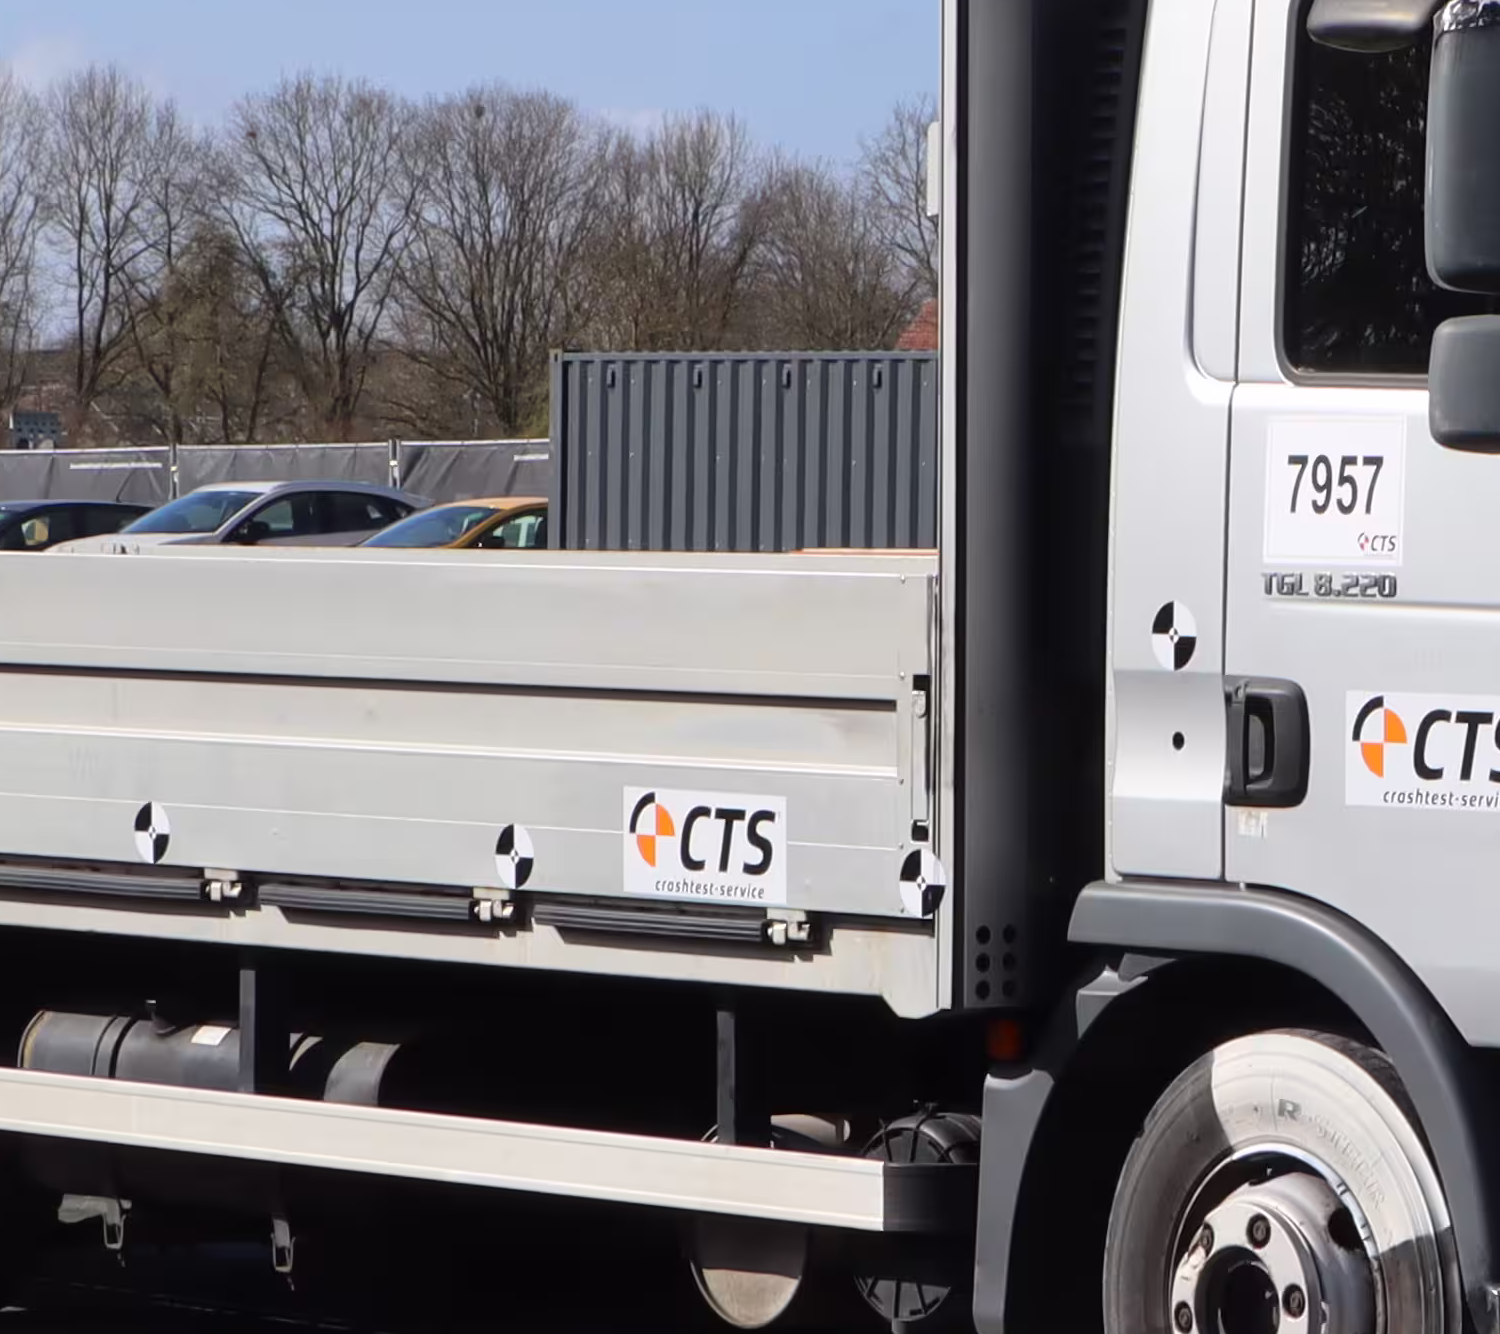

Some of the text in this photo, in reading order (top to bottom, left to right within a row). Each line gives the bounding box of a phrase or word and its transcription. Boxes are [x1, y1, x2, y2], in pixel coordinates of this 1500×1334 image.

[1287, 454, 1384, 515] 7957
[1370, 535, 1396, 552] CTS
[1262, 571, 1397, 599] TGL 8.220
[680, 805, 776, 876] CTS
[655, 877, 765, 900] crashtest-service
